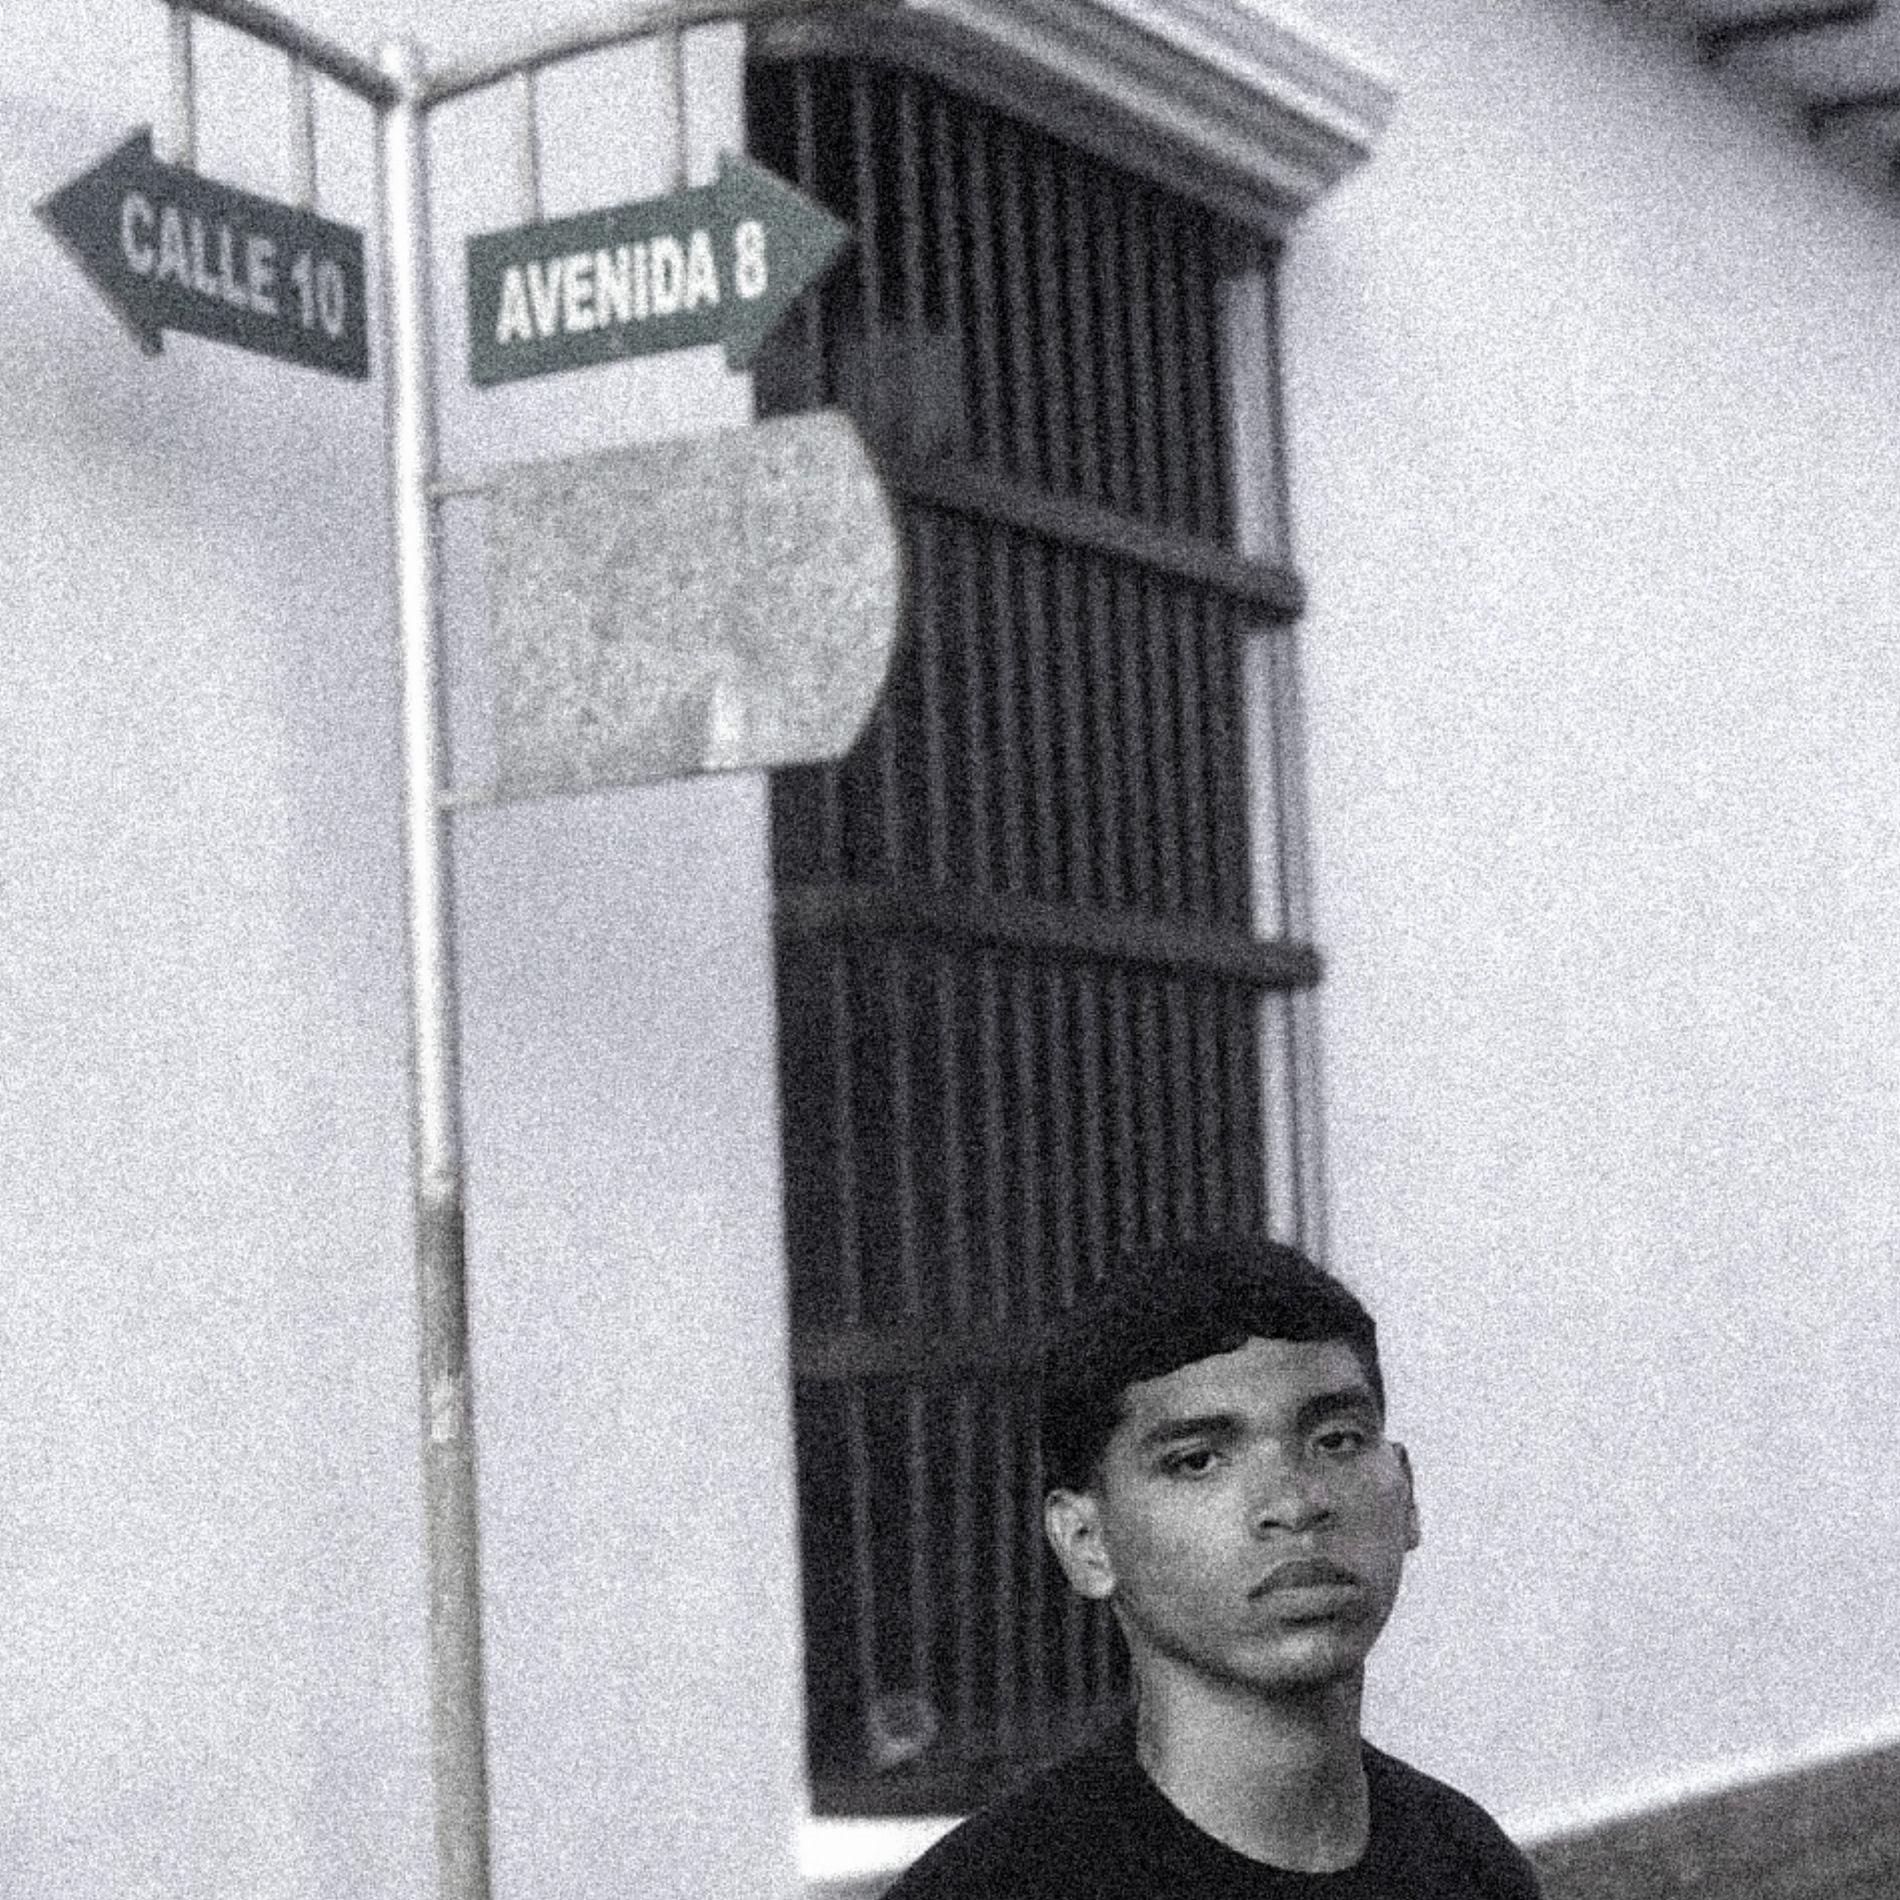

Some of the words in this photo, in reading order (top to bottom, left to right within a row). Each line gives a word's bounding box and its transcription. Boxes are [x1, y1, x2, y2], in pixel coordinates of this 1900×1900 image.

[121, 192, 279, 315] CALLE
[292, 249, 345, 339] 10
[497, 229, 720, 343] AVENIDA
[734, 220, 769, 299] 8
